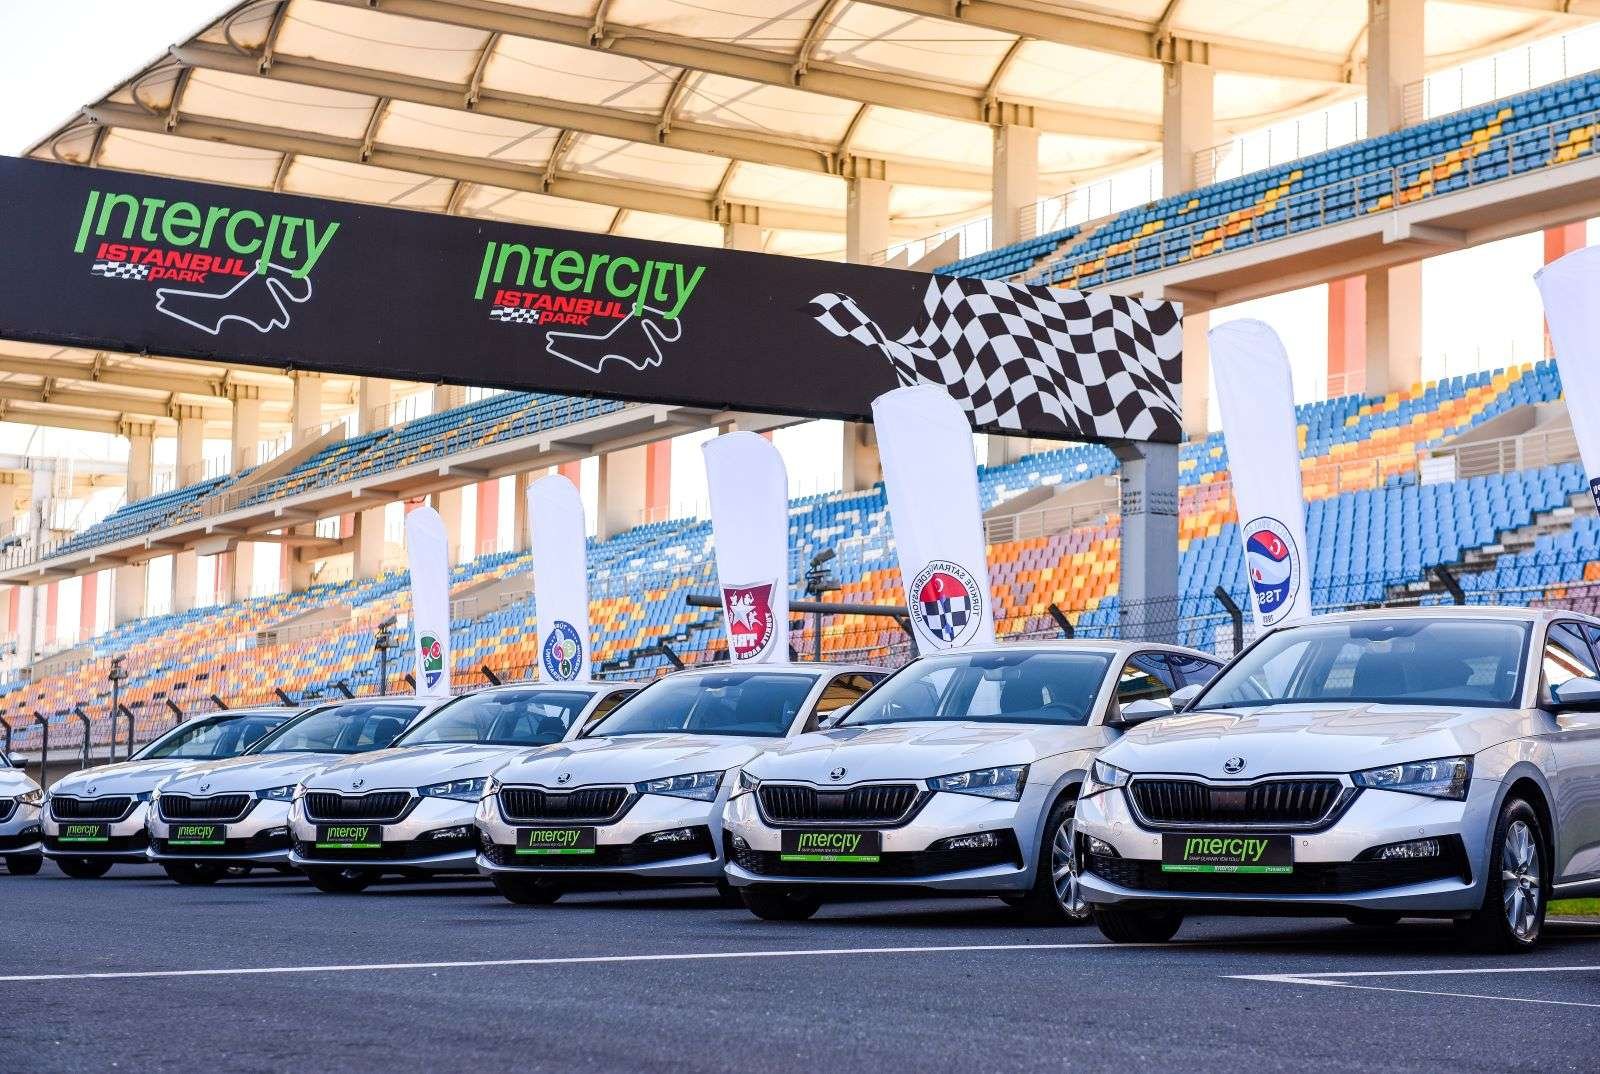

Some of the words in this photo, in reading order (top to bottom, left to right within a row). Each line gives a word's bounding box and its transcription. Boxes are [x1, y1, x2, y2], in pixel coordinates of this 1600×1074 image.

[96, 243, 250, 278] ISTANBUL
[148, 265, 208, 284] PARK
[494, 290, 628, 319] ISTANBUL
[538, 311, 591, 326] PARK
